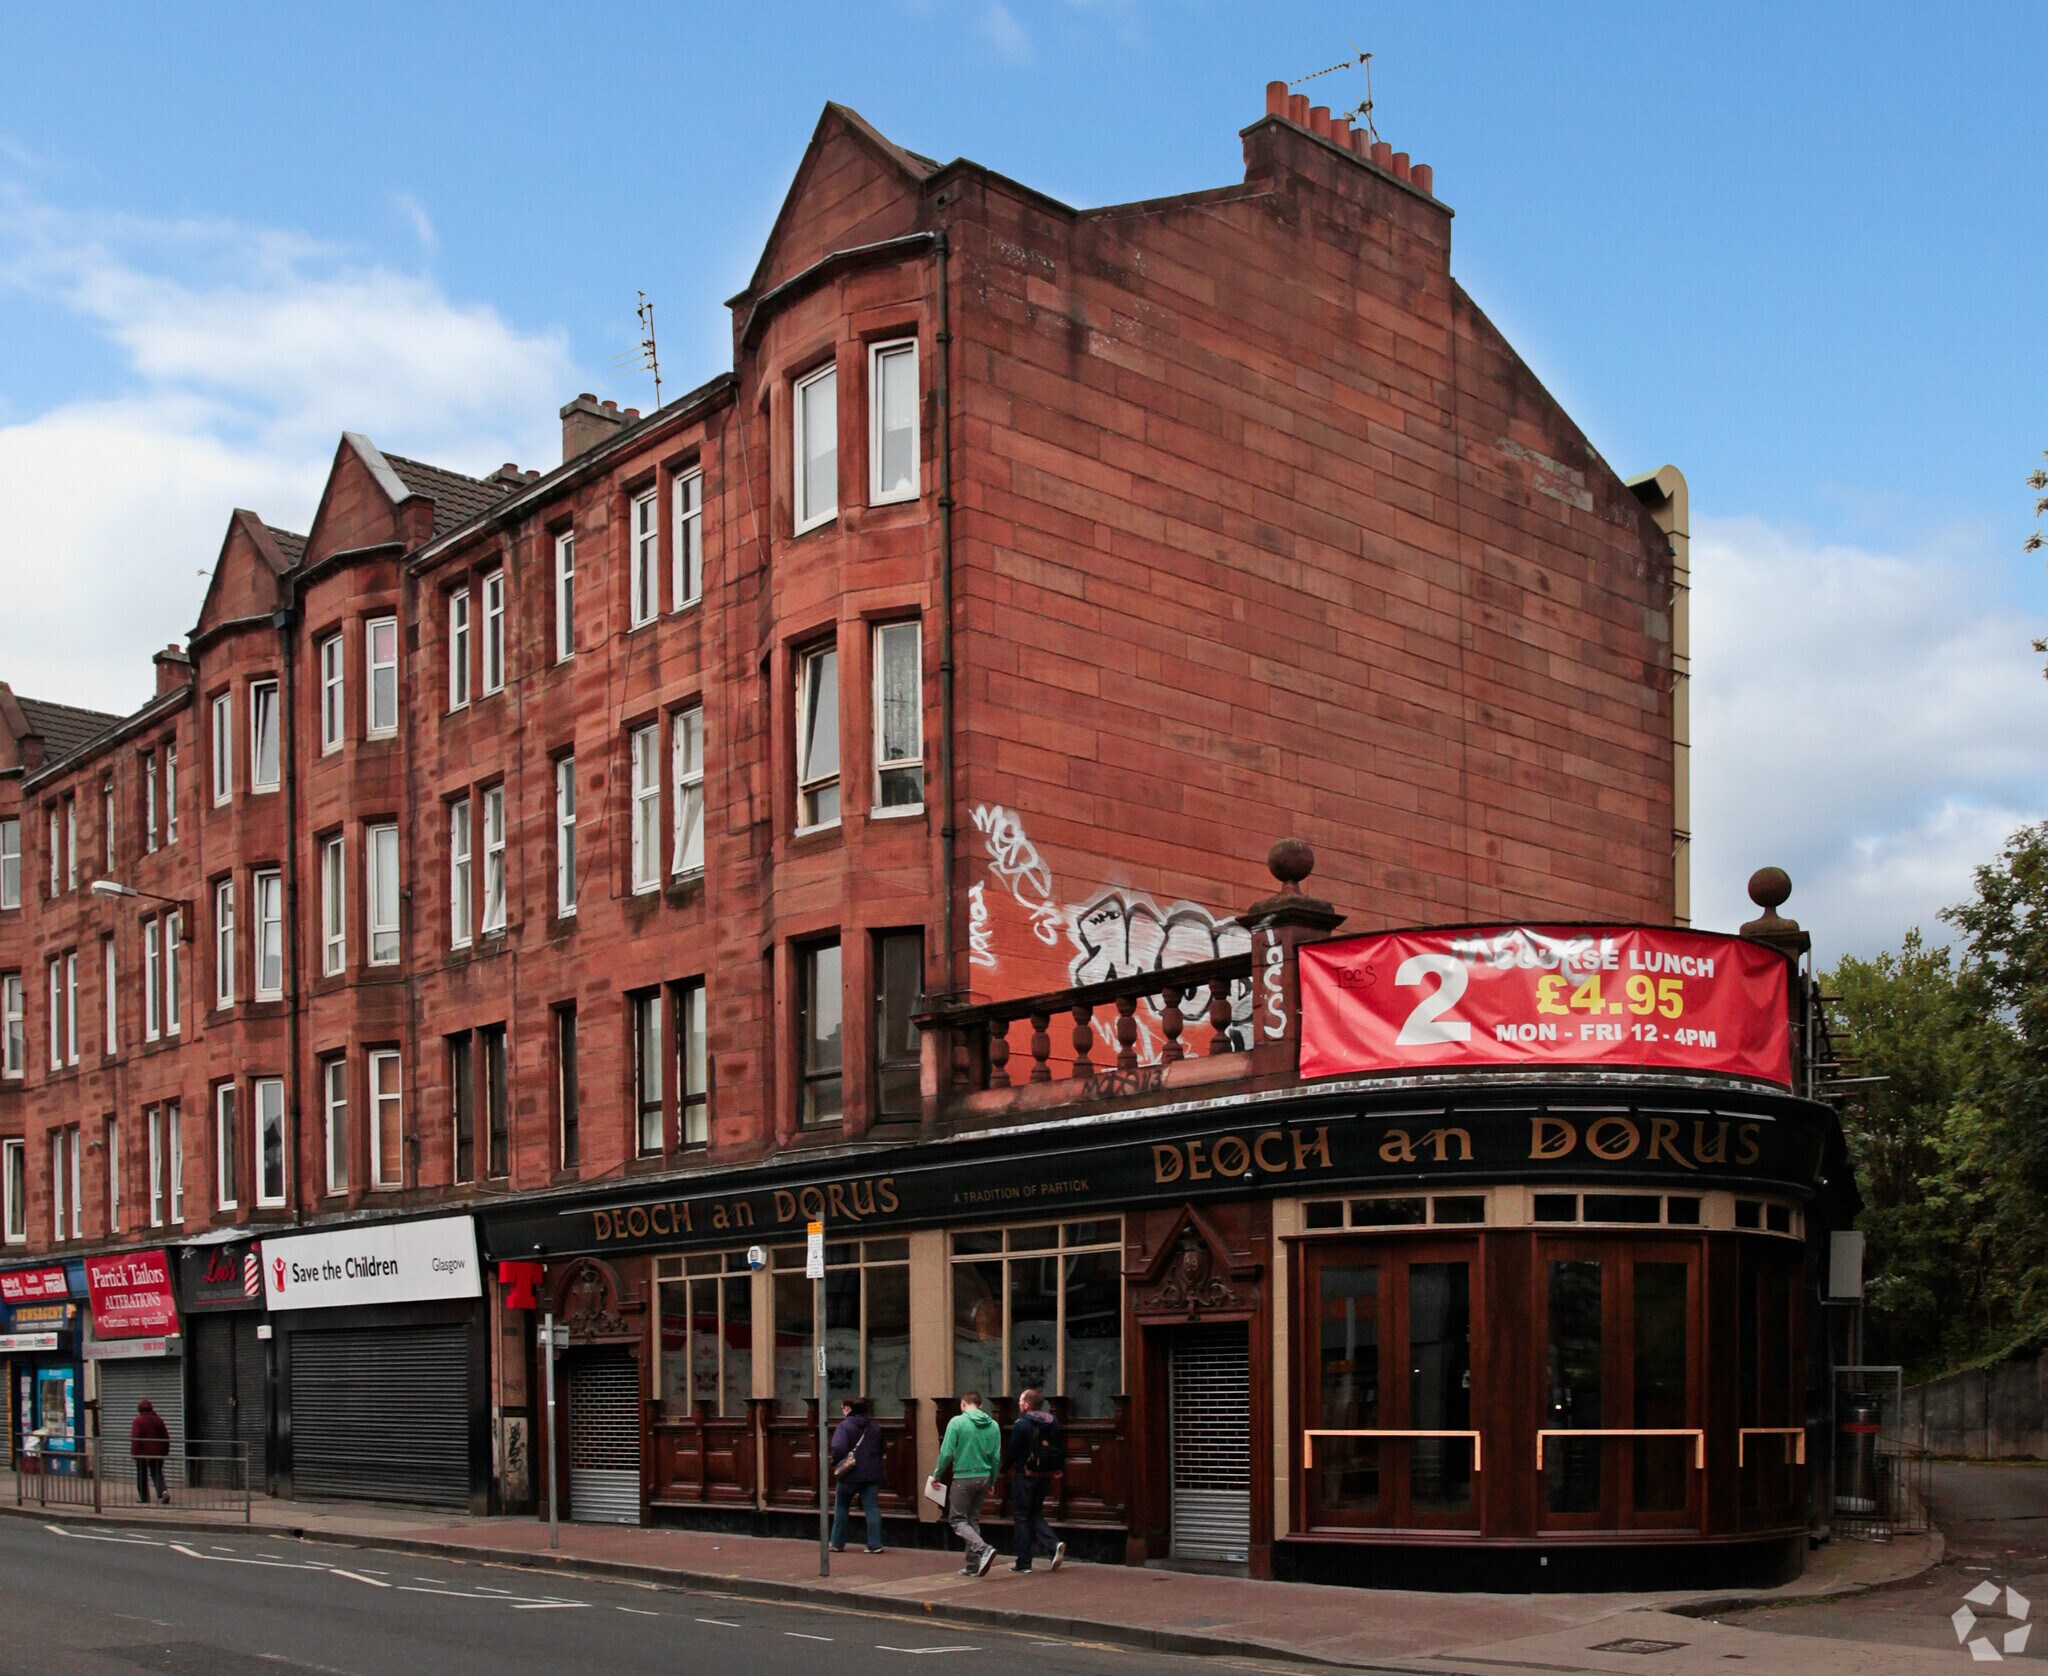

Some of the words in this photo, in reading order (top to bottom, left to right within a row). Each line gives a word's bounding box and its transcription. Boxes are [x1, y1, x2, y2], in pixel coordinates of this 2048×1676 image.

[1395, 954, 1471, 1045] 2
[1629, 949, 1714, 978] LUNCH
[1535, 974, 1684, 1019] £4.95
[1496, 1023, 1557, 1042] MON
[1580, 1024, 1622, 1041] FRI
[1631, 1024, 1659, 1042] 12
[1673, 1028, 1717, 1048] 4PM
[1151, 1126, 1333, 1184] DEOCH
[1378, 1126, 1474, 1164] an
[1527, 1116, 1761, 1171] DORUS
[953, 1193, 961, 1204] A
[963, 1186, 1020, 1203] TRADITION
[1022, 1185, 1038, 1197] OF
[1041, 1179, 1089, 1195] PARTICK
[593, 1201, 693, 1241] DEOCH
[712, 1201, 755, 1229] an
[773, 1177, 900, 1223] DORUS
[91, 1265, 129, 1289] Partick
[128, 1262, 165, 1286] Tailors
[292, 1262, 320, 1283] Save
[322, 1259, 342, 1280] the
[345, 1255, 399, 1279] Children
[431, 1257, 466, 1275] Glasgow
[105, 1291, 161, 1310] ALTERATIONS
